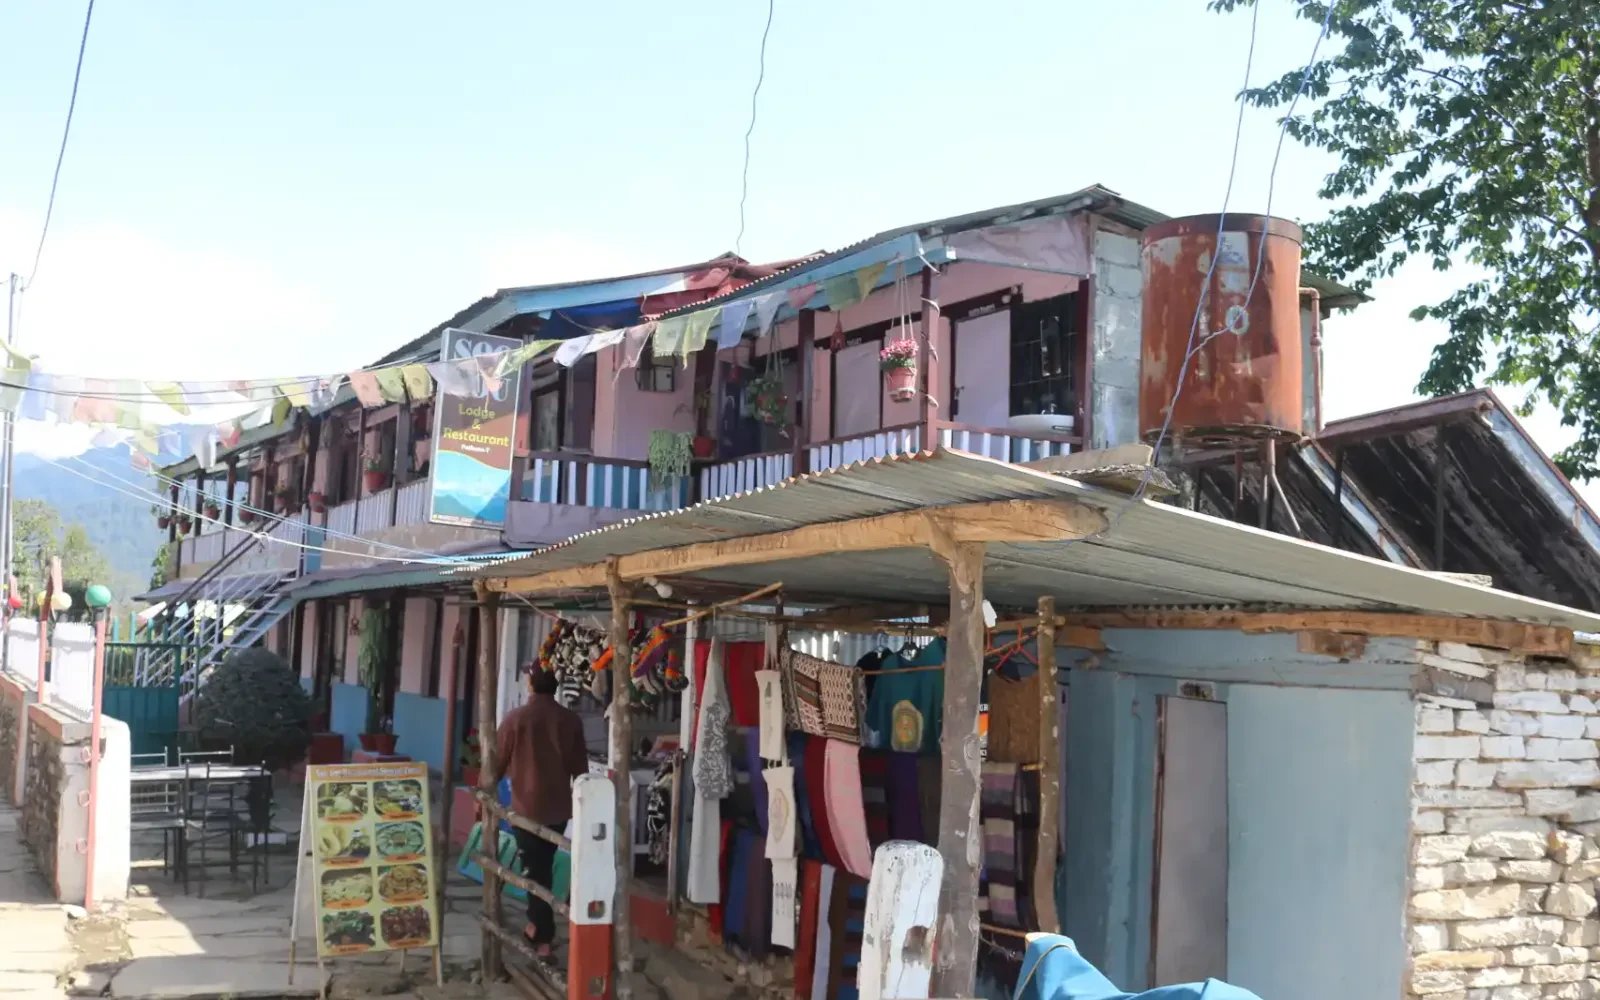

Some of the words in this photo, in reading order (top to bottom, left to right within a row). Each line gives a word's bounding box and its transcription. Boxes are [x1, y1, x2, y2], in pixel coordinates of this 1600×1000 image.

[458, 404, 496, 419] Lodge
[471, 418, 481, 430] &
[443, 427, 510, 447] Restaurant
